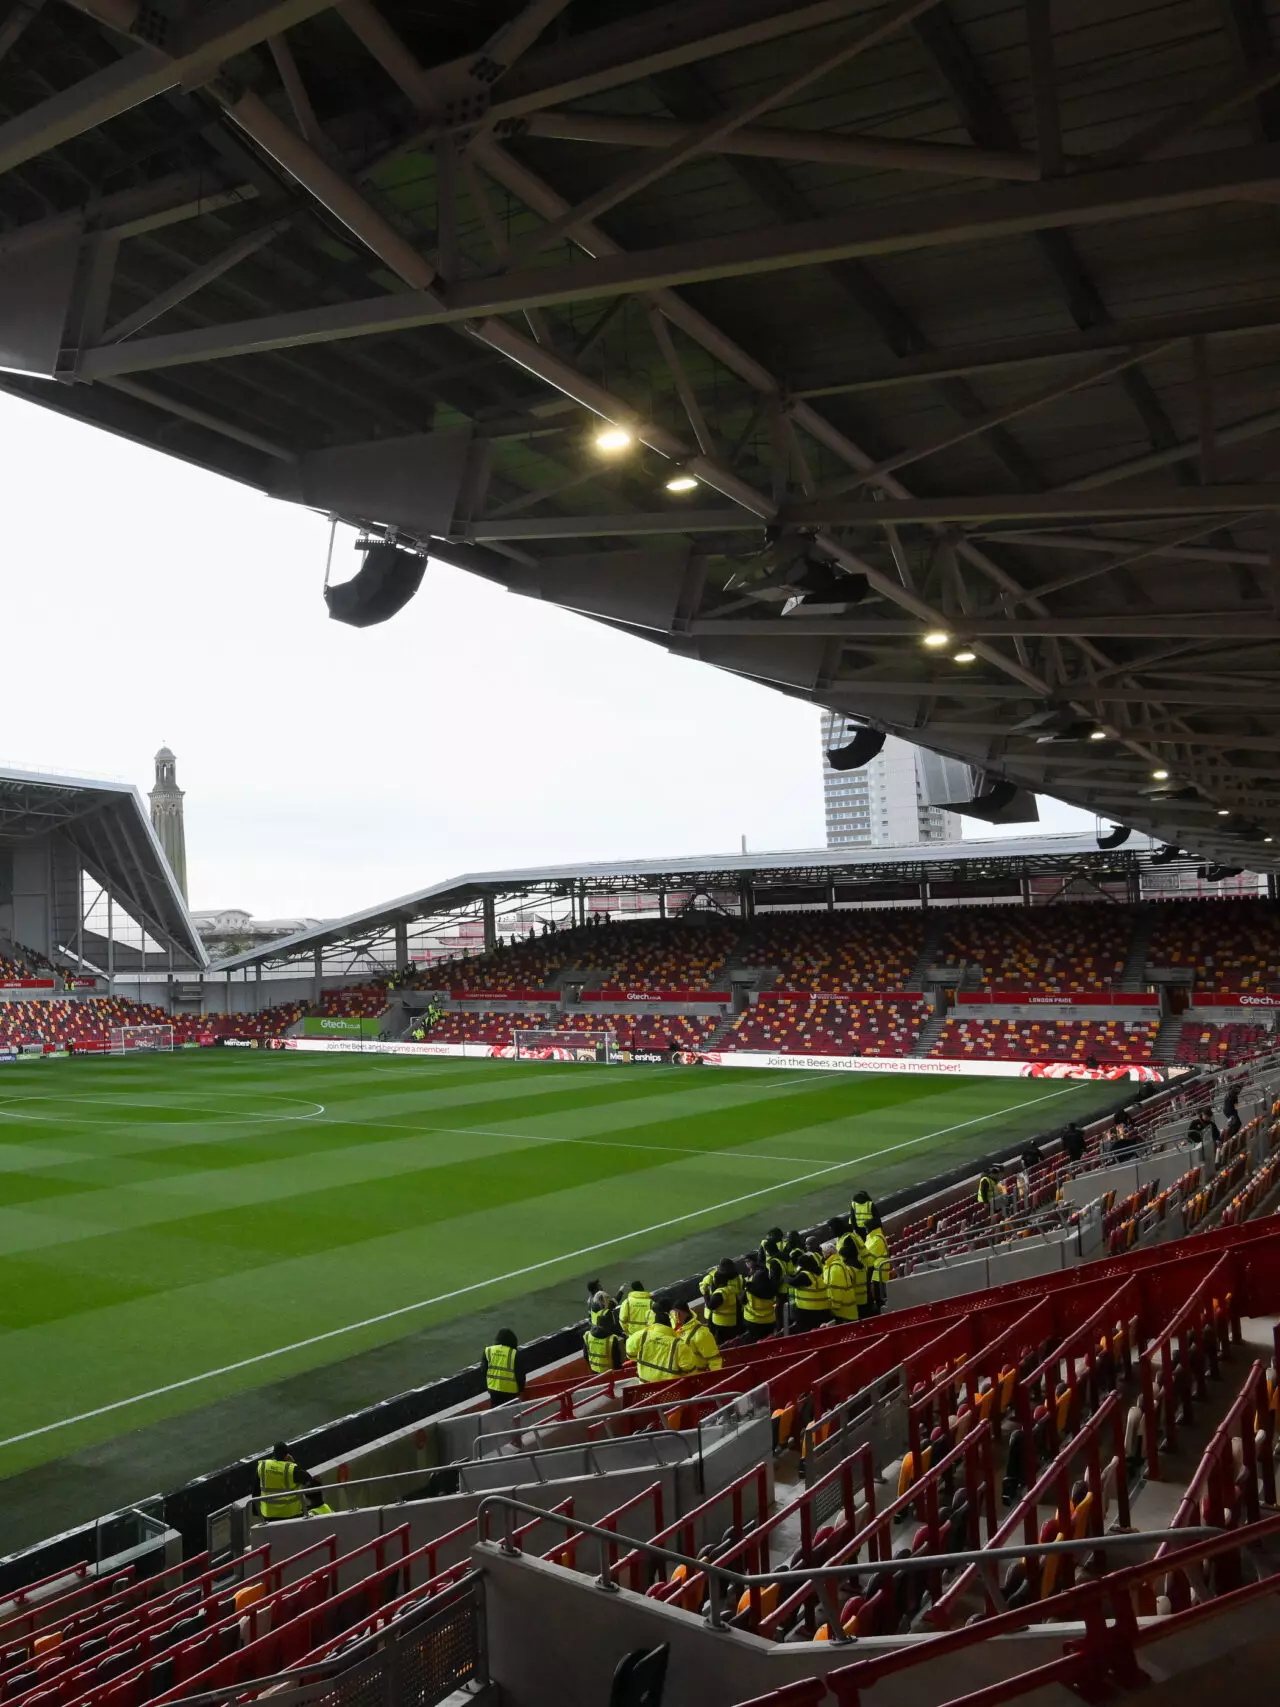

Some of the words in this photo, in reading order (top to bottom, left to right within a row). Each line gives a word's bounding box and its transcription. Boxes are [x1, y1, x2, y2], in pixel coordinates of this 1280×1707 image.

[766, 1057, 787, 1066] Join
[788, 1058, 805, 1066] the
[807, 1058, 830, 1067] Bees
[832, 1059, 852, 1068] and
[854, 1060, 899, 1070] become
[908, 1062, 961, 1072] member!
